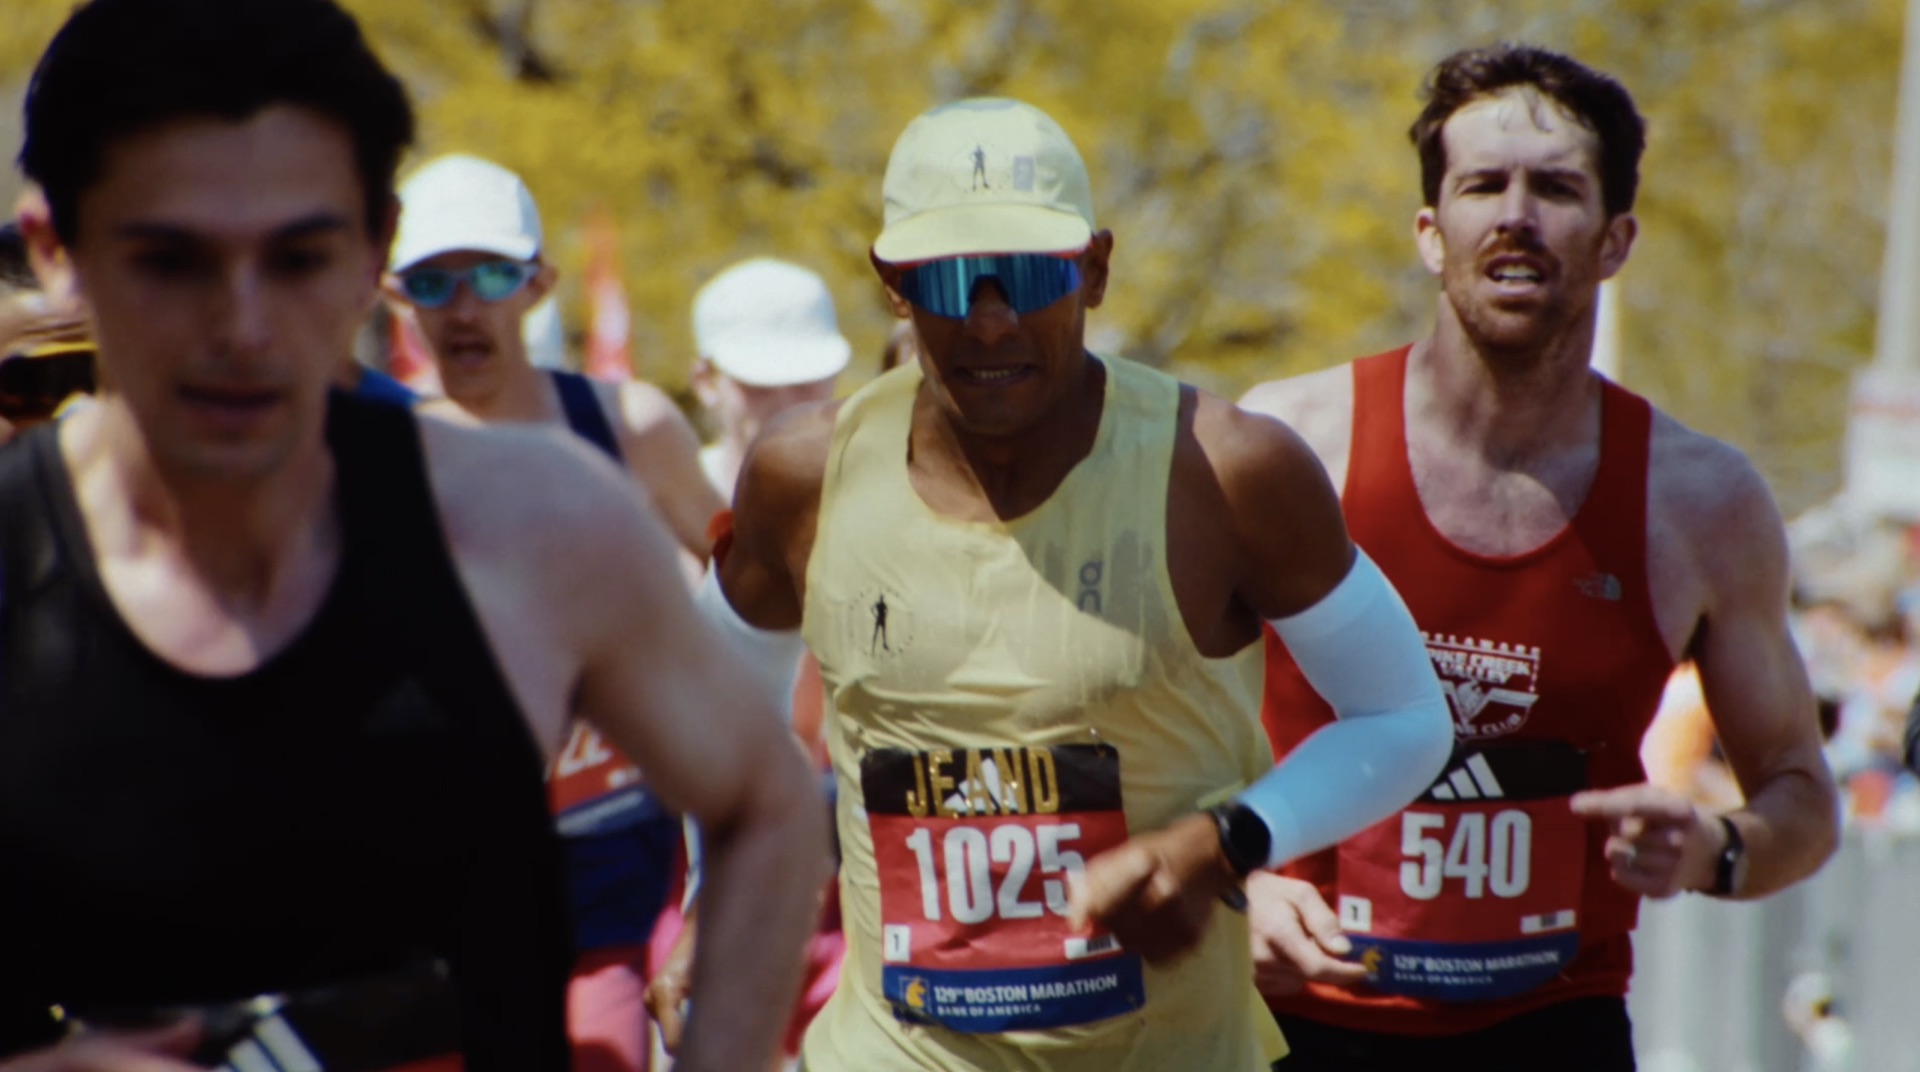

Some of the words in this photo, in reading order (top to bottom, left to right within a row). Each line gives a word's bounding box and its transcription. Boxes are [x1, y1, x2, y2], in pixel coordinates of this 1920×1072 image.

[906, 746, 1060, 818] JEAND
[1399, 809, 1532, 900] 540
[905, 823, 1088, 924] 1025
[1351, 904, 1359, 921] 1
[893, 934, 900, 952] 1
[1425, 956, 1483, 972] BOSTON
[1485, 949, 1560, 971] MARATHON
[964, 984, 1028, 1004] BOSTON
[1030, 974, 1118, 1000] MARATHON
[937, 1005, 968, 1017] BANK
[969, 1005, 984, 1017] OF
[986, 1004, 1042, 1017] AMERICA
